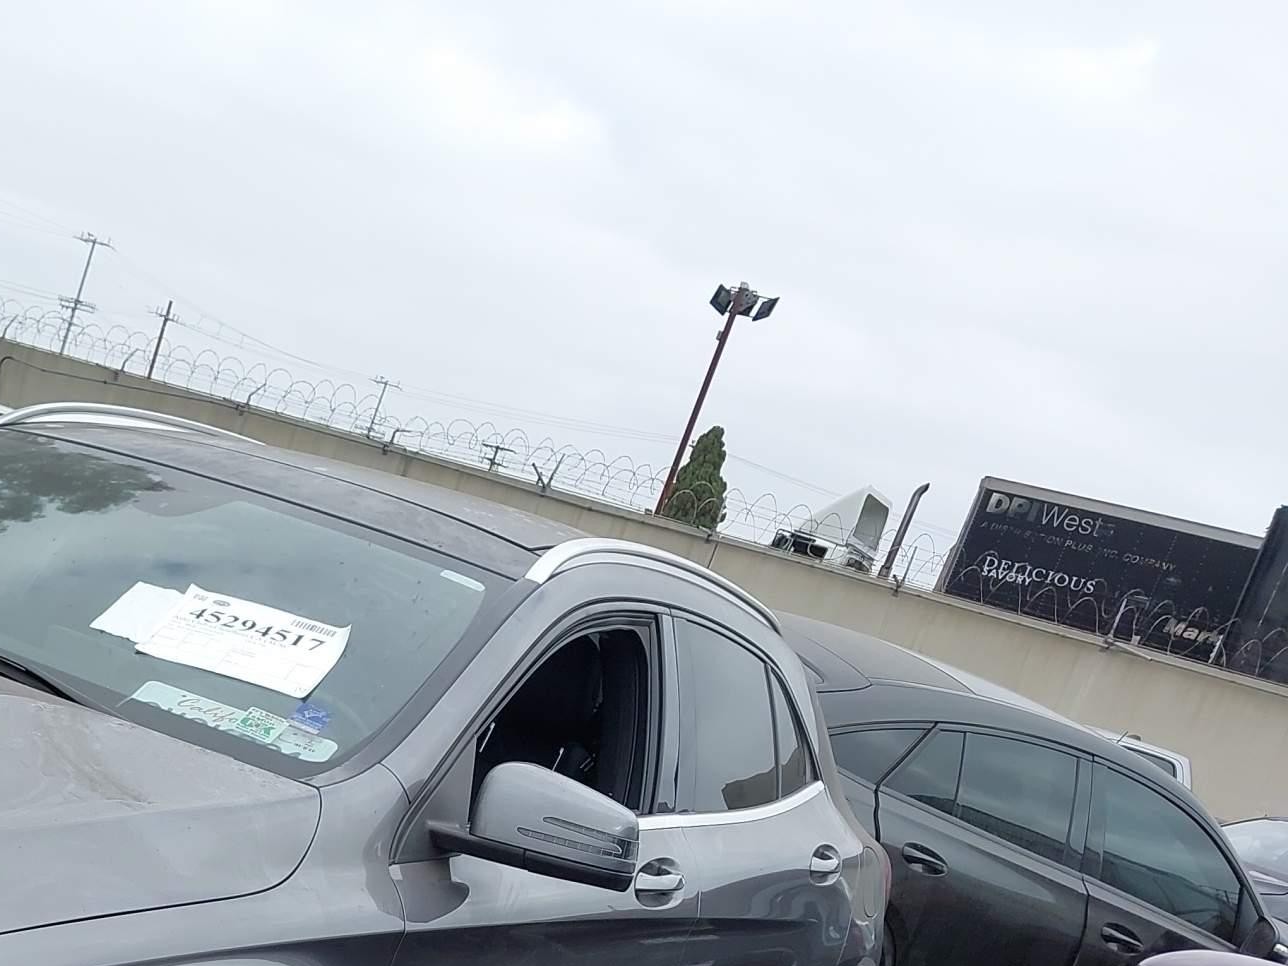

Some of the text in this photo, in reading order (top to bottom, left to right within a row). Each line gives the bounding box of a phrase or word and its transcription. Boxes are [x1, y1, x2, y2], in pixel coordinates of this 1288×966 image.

[985, 491, 1104, 538] DPI West
[981, 567, 1033, 587] SAVORY
[982, 556, 1096, 594] DELICIOUS
[189, 607, 327, 652] 45294517
[176, 698, 237, 728] Califo
